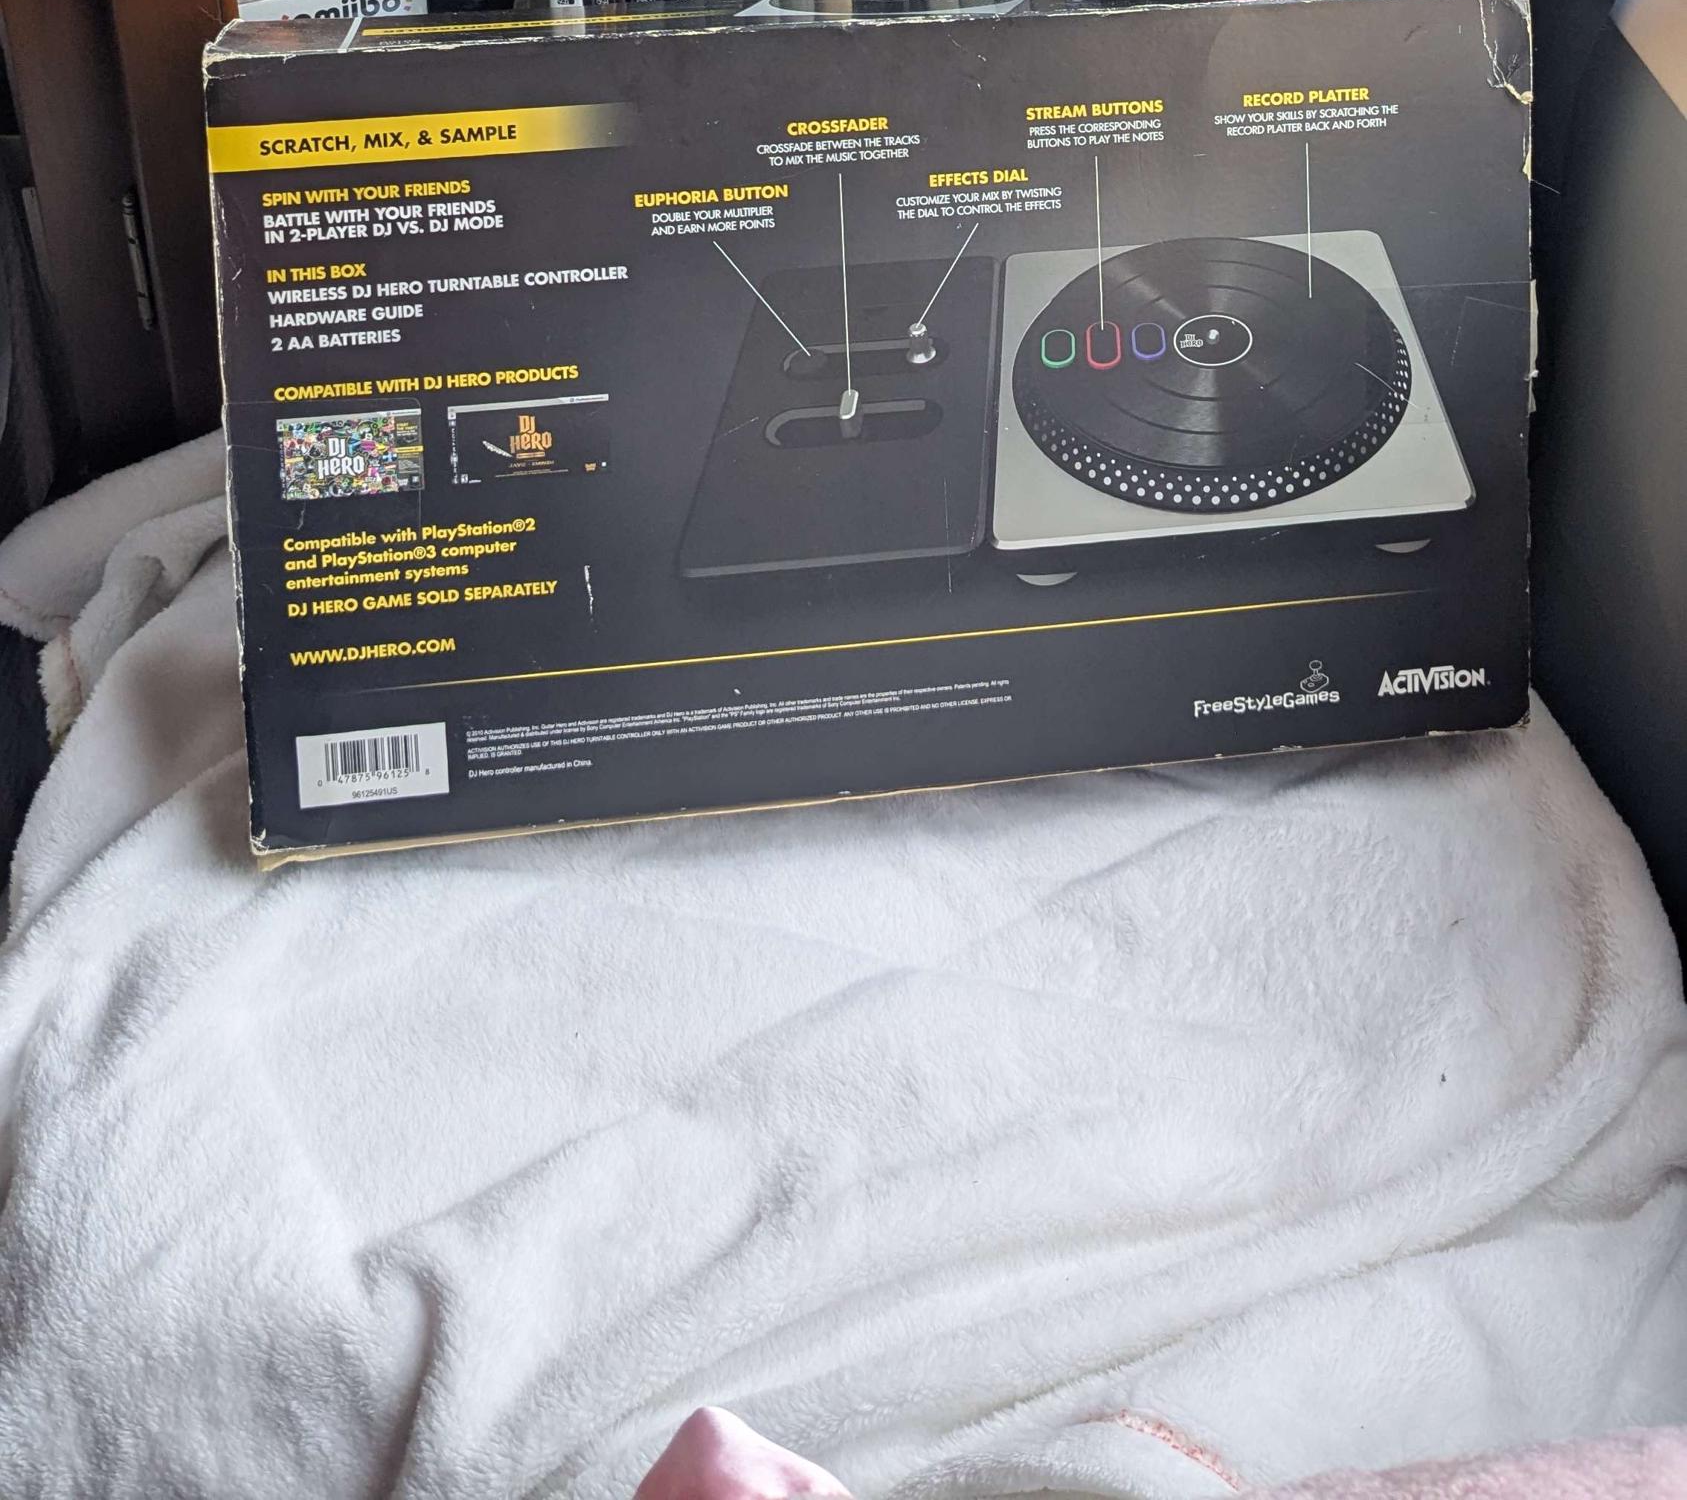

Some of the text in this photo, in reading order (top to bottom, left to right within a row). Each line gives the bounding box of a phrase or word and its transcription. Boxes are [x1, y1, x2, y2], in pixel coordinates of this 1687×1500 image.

[1243, 88, 1369, 107] RECORD PLATTER
[1026, 100, 1163, 120] STREAM BUTTONS
[1214, 105, 1399, 125] SHOW YOUR SKILLS BY SCRATCHING THE
[787, 117, 888, 135] CROSSFADER
[1227, 118, 1387, 136] RECORD PLATTER BACK AND FORTH
[260, 125, 516, 156] SCRATCH, MIX, & SAMPLE
[756, 135, 920, 155] CROSSFADE BETWEEN THE TRACKS
[769, 149, 909, 166] TO MIX THE MUSIC TOGETHER
[929, 169, 1028, 187] EFFECTS DIAL
[262, 180, 470, 207] SPIN WITH YOUR FRIENDS
[635, 185, 788, 207] EUPHORIA BUTTON
[264, 200, 496, 228] BATTLE WITH YOUR FRIENDS
[264, 215, 503, 244] IN 2-PLAYER DJ VS. DJ MODE
[267, 264, 366, 283] IN THIS BOX
[267, 266, 628, 305] WIRELESS DJ HERO TURNTABLE CONTROLLER
[270, 305, 423, 328] HARDWARE GUIDE
[271, 329, 401, 351] 2 AA BATTERIES
[274, 366, 579, 401] COMPATIBLE WITH DJ HERO PRODUCTS
[519, 415, 535, 433] DJ
[328, 437, 346, 457] DJ
[283, 518, 536, 552] Compatible with PlayStation®2
[285, 541, 516, 570] and PlayStation®3 computer
[286, 564, 469, 590] entertainment systems
[288, 581, 557, 617] DJ HERO GAME SOLD SEPARATELY
[290, 638, 455, 666] WWW.DJHERO.COM
[1378, 666, 1485, 696] ACTIVISION
[1194, 691, 1339, 717] FreeStyleGames
[338, 772, 370, 784] 47875
[469, 770, 477, 778] DJ
[524, 762, 565, 772] manufactured
